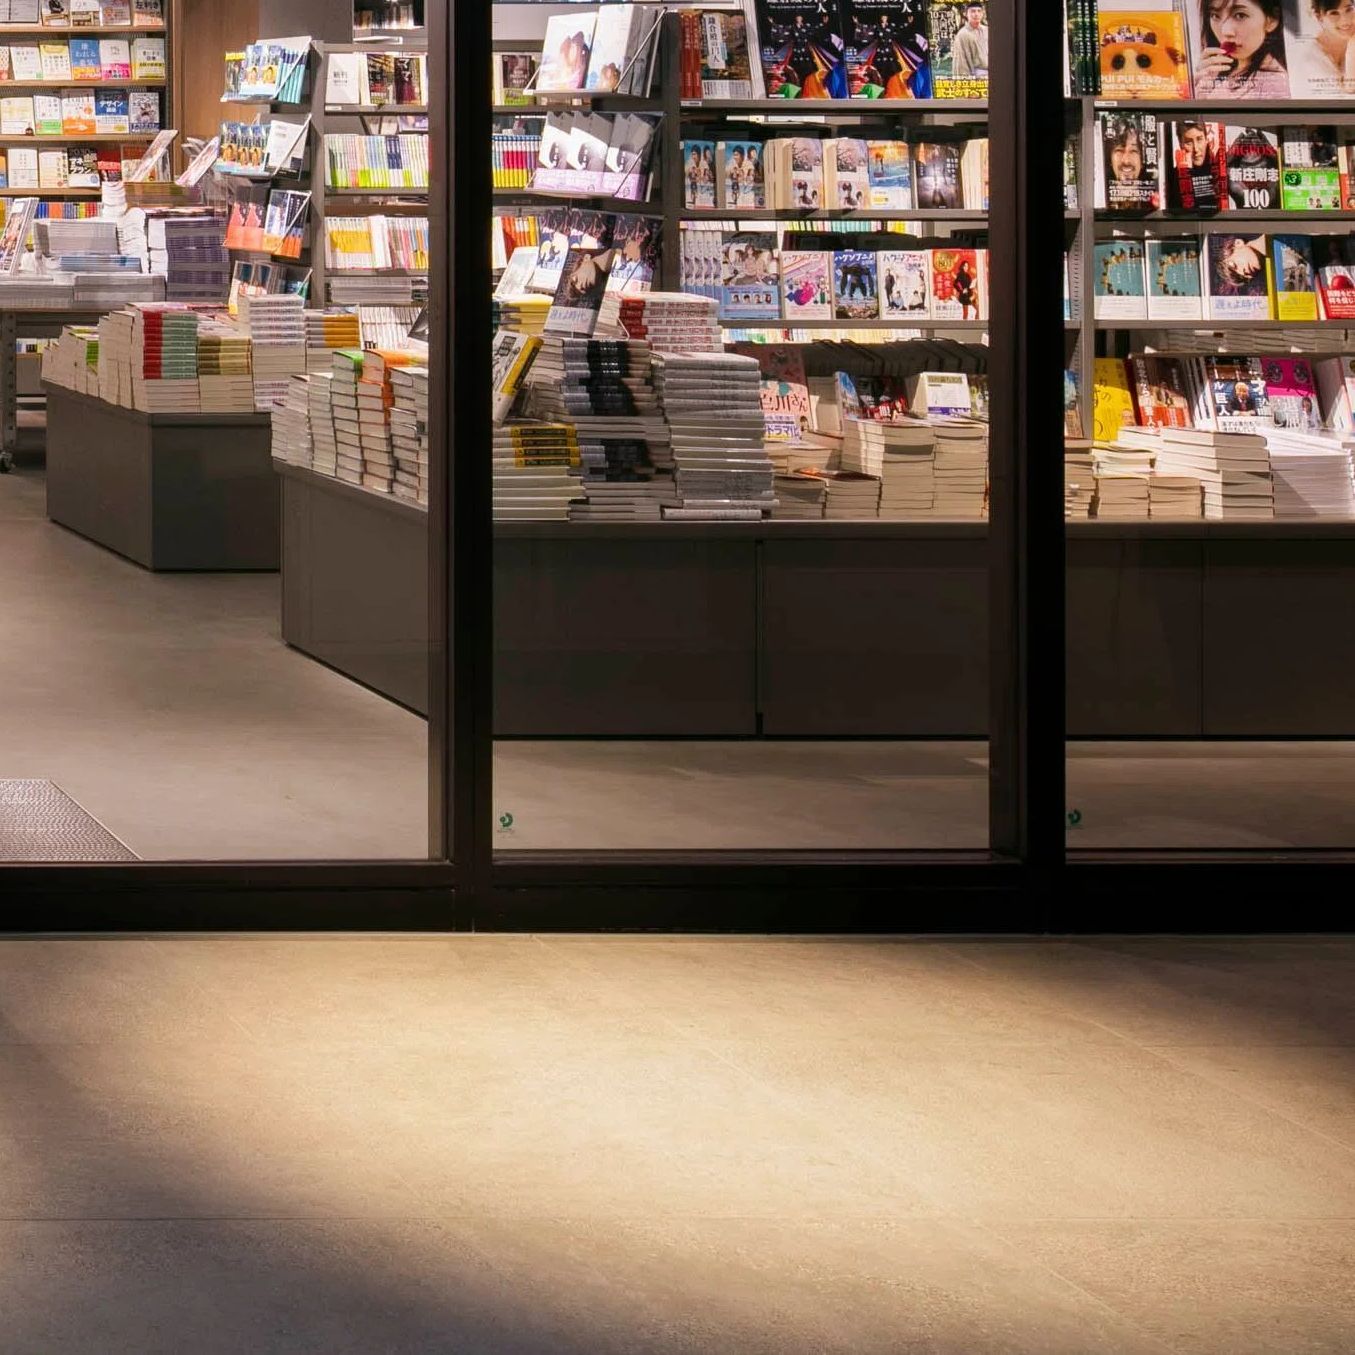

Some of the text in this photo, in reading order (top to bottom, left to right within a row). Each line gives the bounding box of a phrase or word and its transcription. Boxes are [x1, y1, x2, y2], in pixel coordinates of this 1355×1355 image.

[1229, 167, 1279, 182] 新庄剛志
[1243, 189, 1271, 209] 100
